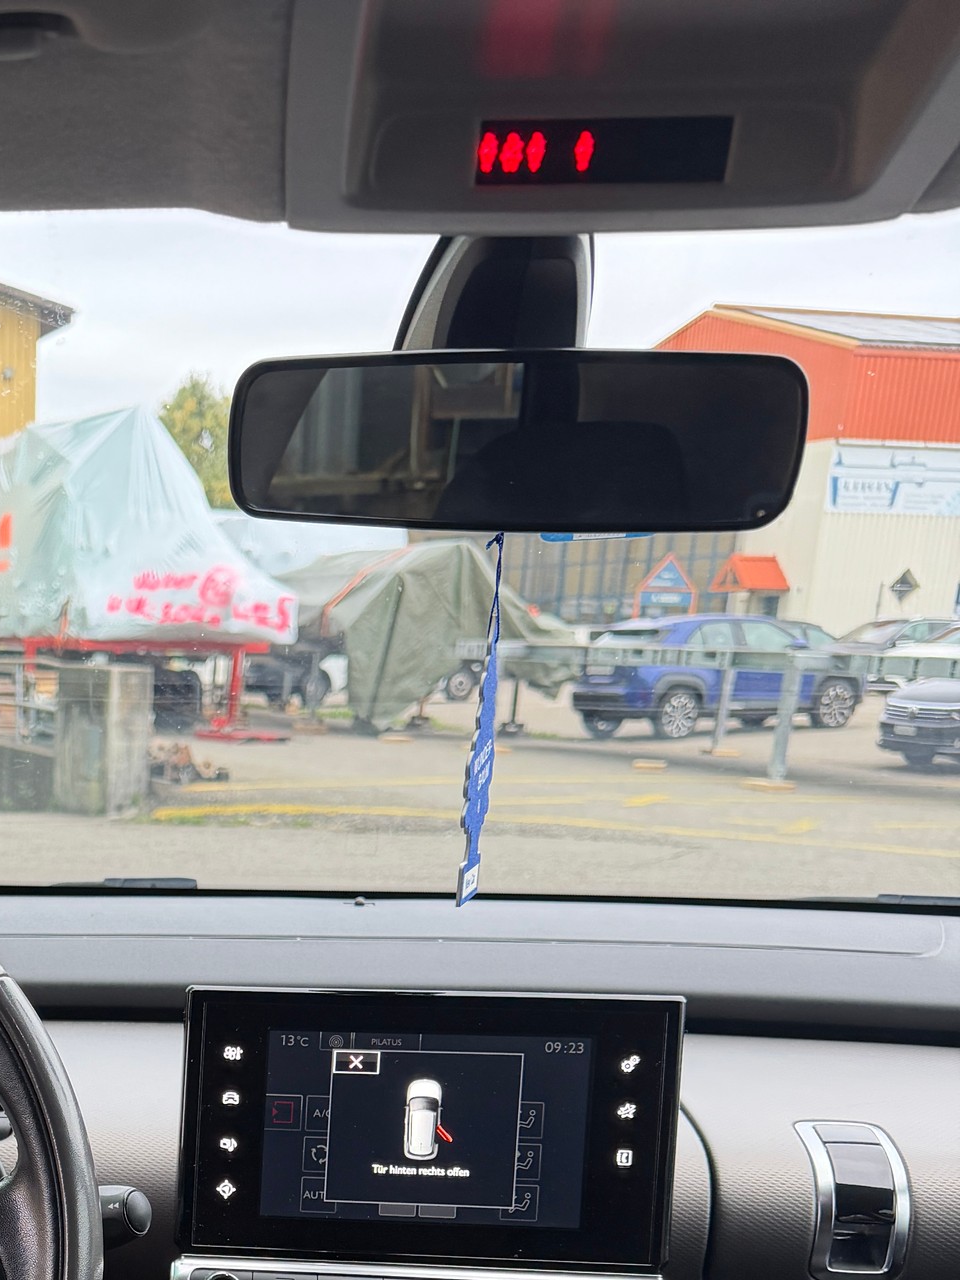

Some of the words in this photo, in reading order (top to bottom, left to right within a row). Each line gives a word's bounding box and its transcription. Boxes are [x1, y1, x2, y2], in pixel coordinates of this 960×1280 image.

[280, 1034, 309, 1047] 13°C
[371, 1038, 402, 1046] PILATUS
[544, 1041, 584, 1054] 09:23
[371, 1163, 388, 1174] Tür
[389, 1164, 417, 1176] hinten
[418, 1165, 445, 1177] rechts
[446, 1166, 470, 1178] offen
